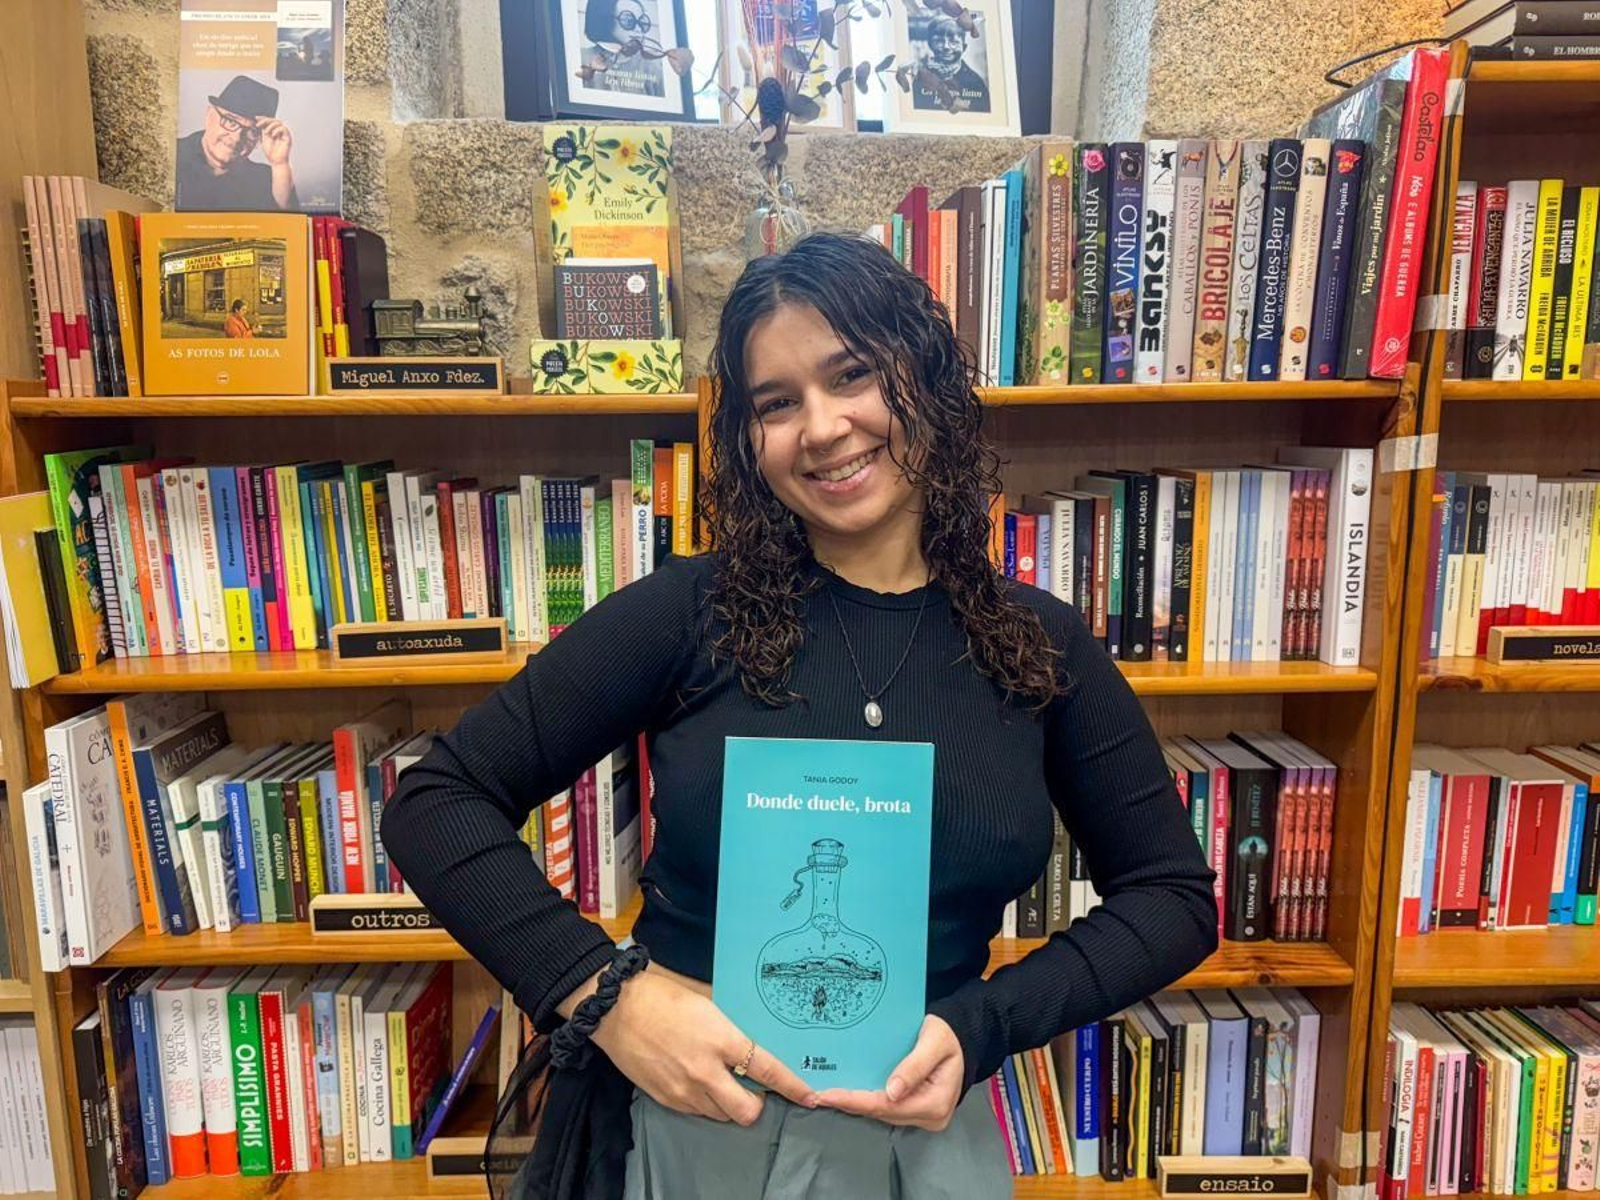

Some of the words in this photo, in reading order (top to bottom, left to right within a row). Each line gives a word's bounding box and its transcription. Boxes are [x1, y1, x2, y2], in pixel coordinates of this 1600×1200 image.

[1553, 46, 1567, 56] EL
[604, 197, 633, 209] Emily
[1052, 184, 1063, 243] SILVESTRES
[1188, 185, 1201, 232] PONIS
[1336, 181, 1349, 216] España
[1547, 197, 1558, 208] LA
[594, 210, 644, 222] Dickinson
[1369, 194, 1386, 236] jardín
[1451, 194, 1475, 256] VENGANZA
[1522, 202, 1535, 243] JULIA
[1545, 209, 1557, 234] MUJER
[1562, 219, 1575, 229] EL
[1081, 187, 1100, 296] JARDINERÍA
[1296, 264, 1305, 301] COCINA
[1301, 189, 1313, 243] CONVENTOS
[1308, 214, 1320, 284] MONASTERIOS
[1332, 223, 1345, 251] Vinos
[1368, 245, 1379, 259] por
[1372, 232, 1380, 246] mi
[1543, 236, 1555, 247] DE
[1559, 229, 1574, 265] RECLUSO
[1050, 246, 1061, 290] PLANTAS
[1201, 198, 1235, 321] BRICOLAJE
[1400, 247, 1411, 259] DE
[1541, 249, 1553, 278] ARRIBA
[1182, 244, 1197, 315] CABALLOS
[1256, 206, 1286, 341] Mercedes-Benz
[1360, 260, 1377, 295] Viajes
[1395, 261, 1409, 297] GUERRA
[1515, 248, 1533, 320] NAVARRO
[565, 297, 652, 311] BUKOWSKI
[566, 310, 653, 325] BUKOWSKI
[567, 323, 654, 338] BUKOWSKI
[168, 347, 184, 359] AS
[187, 347, 225, 359] FOTOS
[229, 347, 246, 358] DE
[249, 347, 281, 358] LOLA
[341, 369, 397, 388] Miguel
[402, 370, 440, 384] Anxo
[445, 370, 486, 385] Fdez.
[198, 493, 208, 515] SALUD
[660, 480, 669, 503] PODA
[365, 503, 374, 530] PODER
[660, 504, 669, 514] LA
[1140, 490, 1148, 525] CARLOS
[458, 525, 467, 552] Sharma
[638, 509, 648, 542] PERRO
[1061, 509, 1071, 542] JULIA
[1113, 508, 1122, 543] CURANDO
[1139, 525, 1147, 550] JUAN
[204, 533, 213, 550] BOCA
[206, 551, 214, 560] LA
[207, 561, 215, 570] DE
[369, 548, 379, 578] AHORA
[1060, 542, 1071, 592] NAVARRO
[1112, 552, 1121, 579] MUNDO
[1344, 523, 1364, 613] ISLANDIA
[386, 573, 396, 606] SECRETO
[1135, 566, 1145, 618] Reconciliación
[389, 606, 397, 616] EL
[376, 633, 464, 651] autoaxuda
[803, 775, 828, 784] TANIA
[828, 776, 859, 785] GODOY
[230, 791, 243, 843] CONTEMPORARY
[326, 797, 334, 830] MODERN
[746, 792, 803, 810] Donde
[807, 794, 860, 815] duele,
[864, 796, 912, 813] brota
[147, 799, 169, 866] MATERIALS
[252, 819, 263, 855] CLAUDE
[288, 818, 299, 851] EDWARD
[344, 821, 358, 843] YORK
[1216, 827, 1225, 855] CABEZA
[1460, 823, 1471, 867] COMPLETA
[31, 835, 41, 866] GALICIA
[236, 843, 246, 869] HOUSES
[272, 832, 286, 880] GAUGUIN
[303, 816, 315, 856] EDVARD
[309, 857, 320, 894] MUNCH
[328, 831, 337, 865] INTERIOR
[345, 846, 360, 866] NEW
[256, 857, 268, 892] MONET
[291, 851, 301, 883] HOPPER
[1247, 873, 1257, 895] AQUÍ
[1456, 868, 1467, 898] POESÍA
[351, 910, 431, 929] outros
[1053, 892, 1062, 921] CELTA
[1246, 895, 1256, 919] ESTÁN
[172, 999, 189, 1068] ARGUIÑANO
[206, 998, 223, 1067] ARGUIÑANO
[164, 1033, 177, 1076] KARLOS
[201, 1032, 213, 1074] KARLOS
[270, 1041, 280, 1071] PASTA
[370, 1037, 385, 1083] Gallega
[273, 1072, 284, 1121] GRANNIES
[359, 1085, 367, 1118] COCINA
[1400, 1060, 1414, 1113] INDILOGIA
[372, 1085, 386, 1128] Cocina
[115, 1157, 124, 1166] LA
[1412, 1140, 1423, 1165] Isabel
[1200, 1177, 1275, 1193] ensaio
